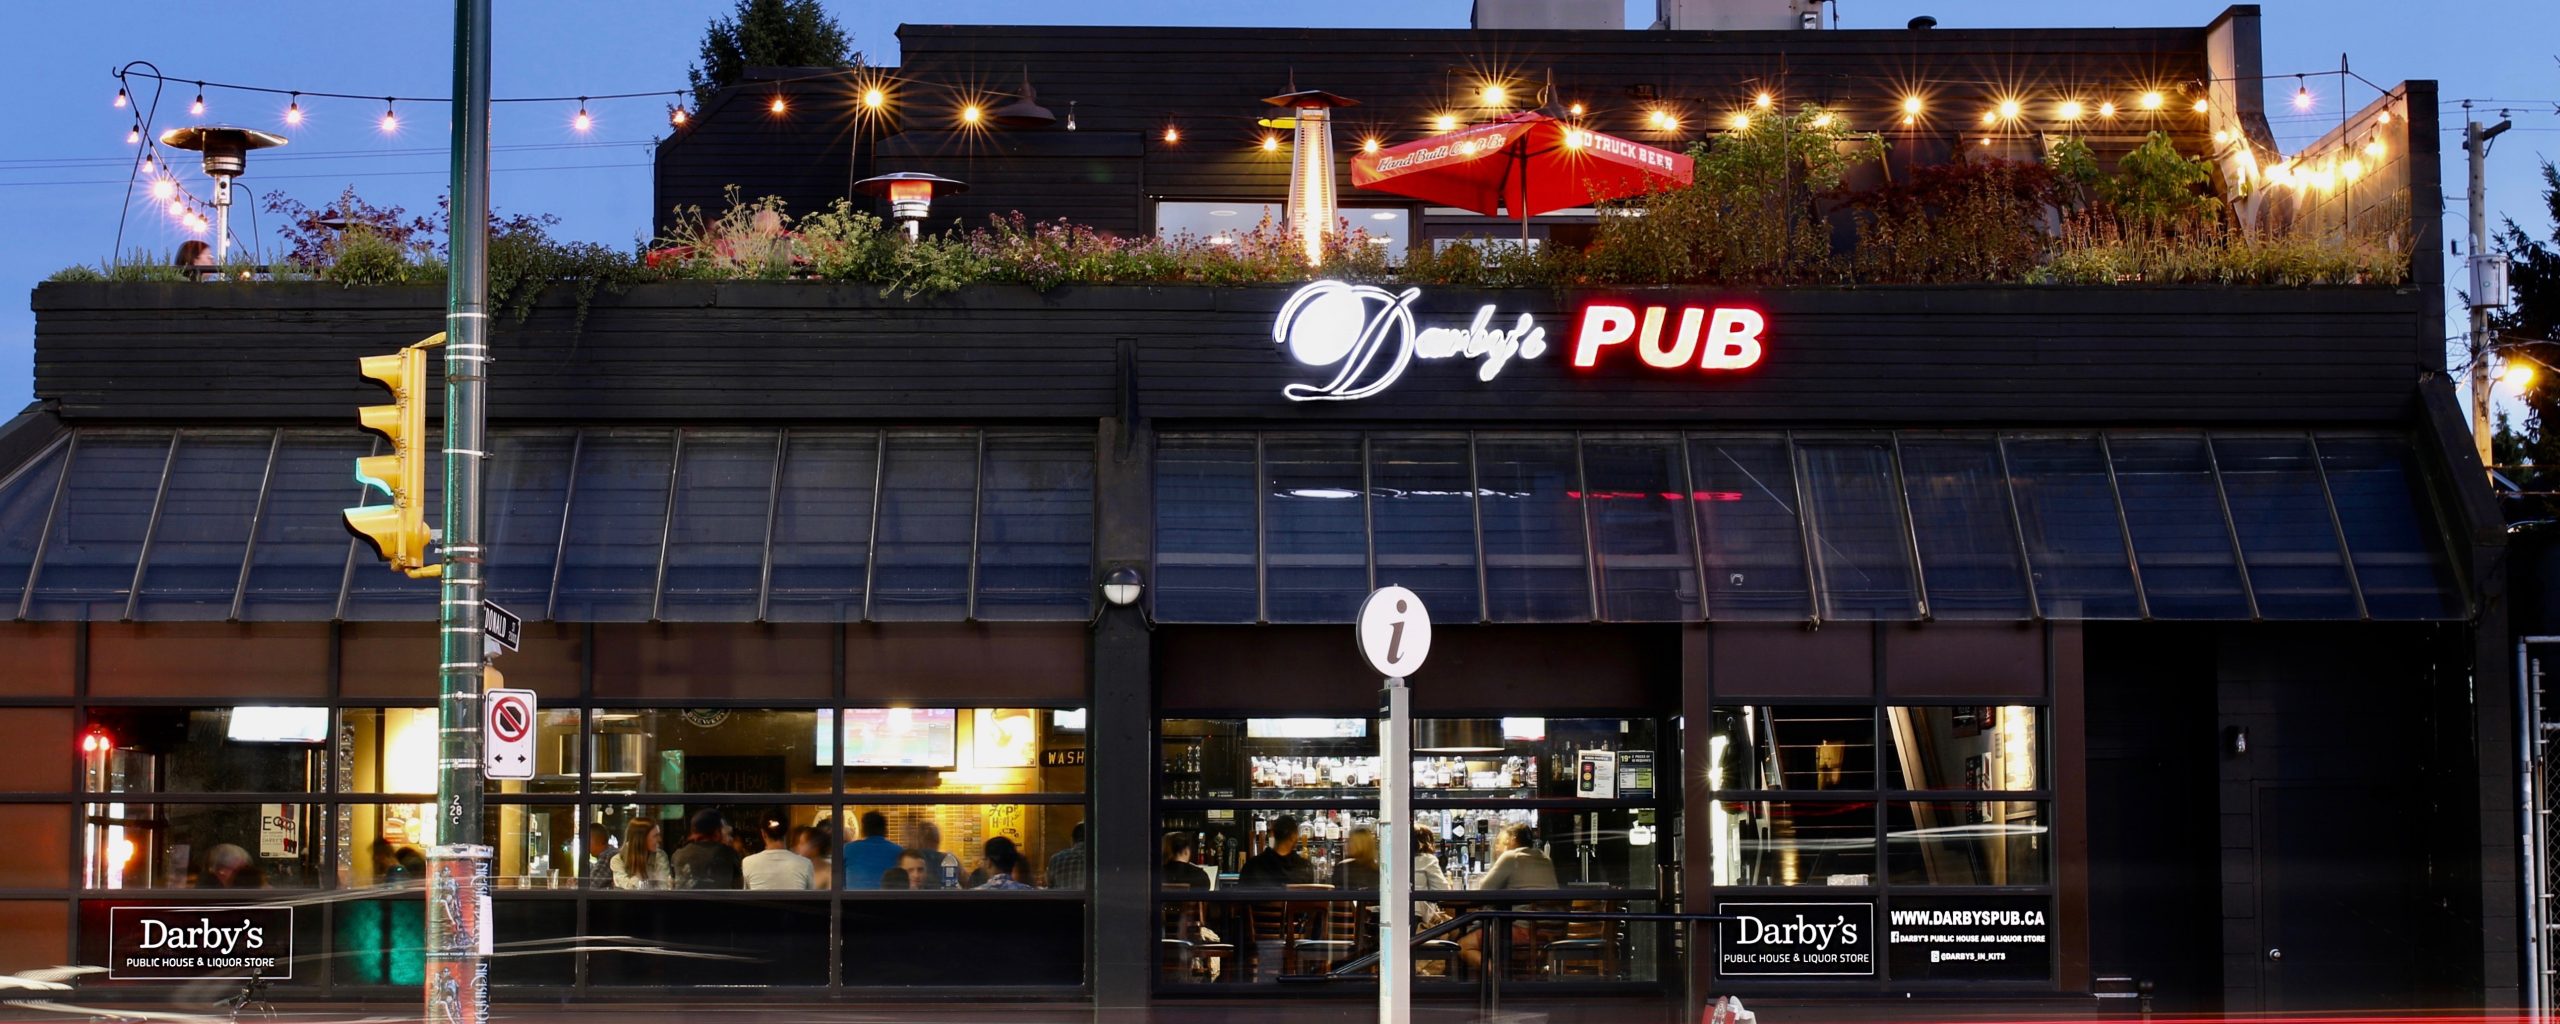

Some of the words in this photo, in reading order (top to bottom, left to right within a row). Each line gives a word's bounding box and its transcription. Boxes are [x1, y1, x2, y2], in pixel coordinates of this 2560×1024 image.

[1376, 153, 1413, 172] Hand
[1414, 146, 1449, 165] Built
[1594, 135, 1637, 159] TRUCK
[1639, 148, 1673, 171] BEER
[1274, 280, 1547, 401] Darby's
[1574, 304, 1765, 370] PUB
[484, 606, 507, 638] DONALD
[453, 794, 460, 805] 2
[449, 805, 463, 816] 28
[1890, 910, 2045, 926] WWW.DARBYSPUB.CA
[139, 917, 264, 955] Darby's
[1736, 914, 1858, 951] Darby's
[1900, 934, 1929, 943] DARBY'S
[1930, 934, 1954, 943] PUBLIC
[1955, 934, 1979, 943] HOUSE
[1980, 934, 1995, 943] AND
[1996, 934, 2022, 943] LIQUOR
[2023, 934, 2046, 943] STORE
[126, 957, 160, 968] PUBLIC
[162, 957, 194, 968] HOUSE
[196, 956, 204, 967] &
[207, 957, 242, 969] LIQUOR
[244, 957, 275, 968] STORE
[1723, 953, 1757, 963] PUBLIC
[1758, 953, 1791, 963] HOUSE
[1793, 953, 1800, 962] &
[1803, 953, 1838, 964] LIQUOR
[1839, 953, 1869, 963] STORE
